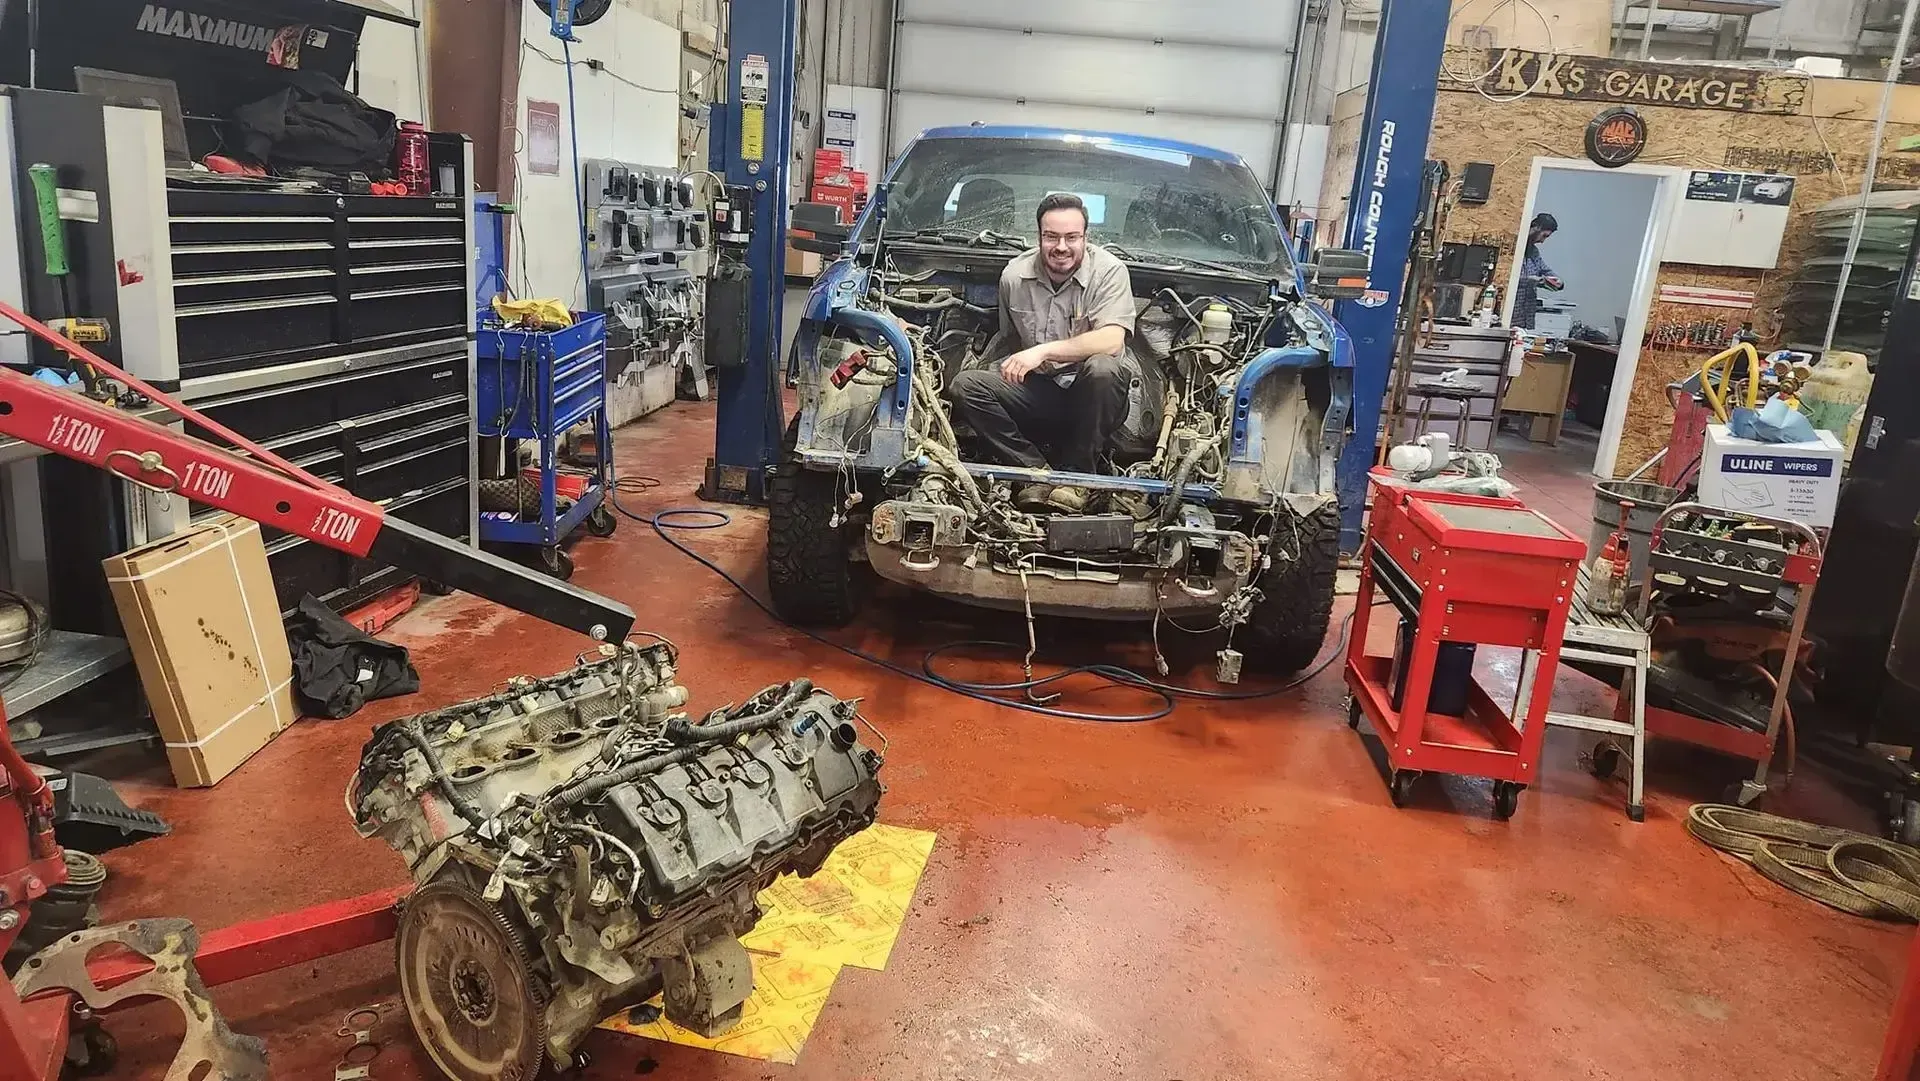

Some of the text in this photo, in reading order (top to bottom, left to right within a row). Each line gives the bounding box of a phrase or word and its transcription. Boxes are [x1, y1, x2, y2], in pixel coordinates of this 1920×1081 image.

[137, 5, 276, 52] MAXIMUM
[1605, 71, 1748, 108] GARAGE
[1373, 120, 1396, 188] ROUGH
[1362, 190, 1383, 289] COUNT
[62, 417, 105, 457] TON
[181, 461, 235, 500] 1 TON
[1730, 458, 1818, 472] ULINE WIPERS
[322, 508, 362, 544] TON
